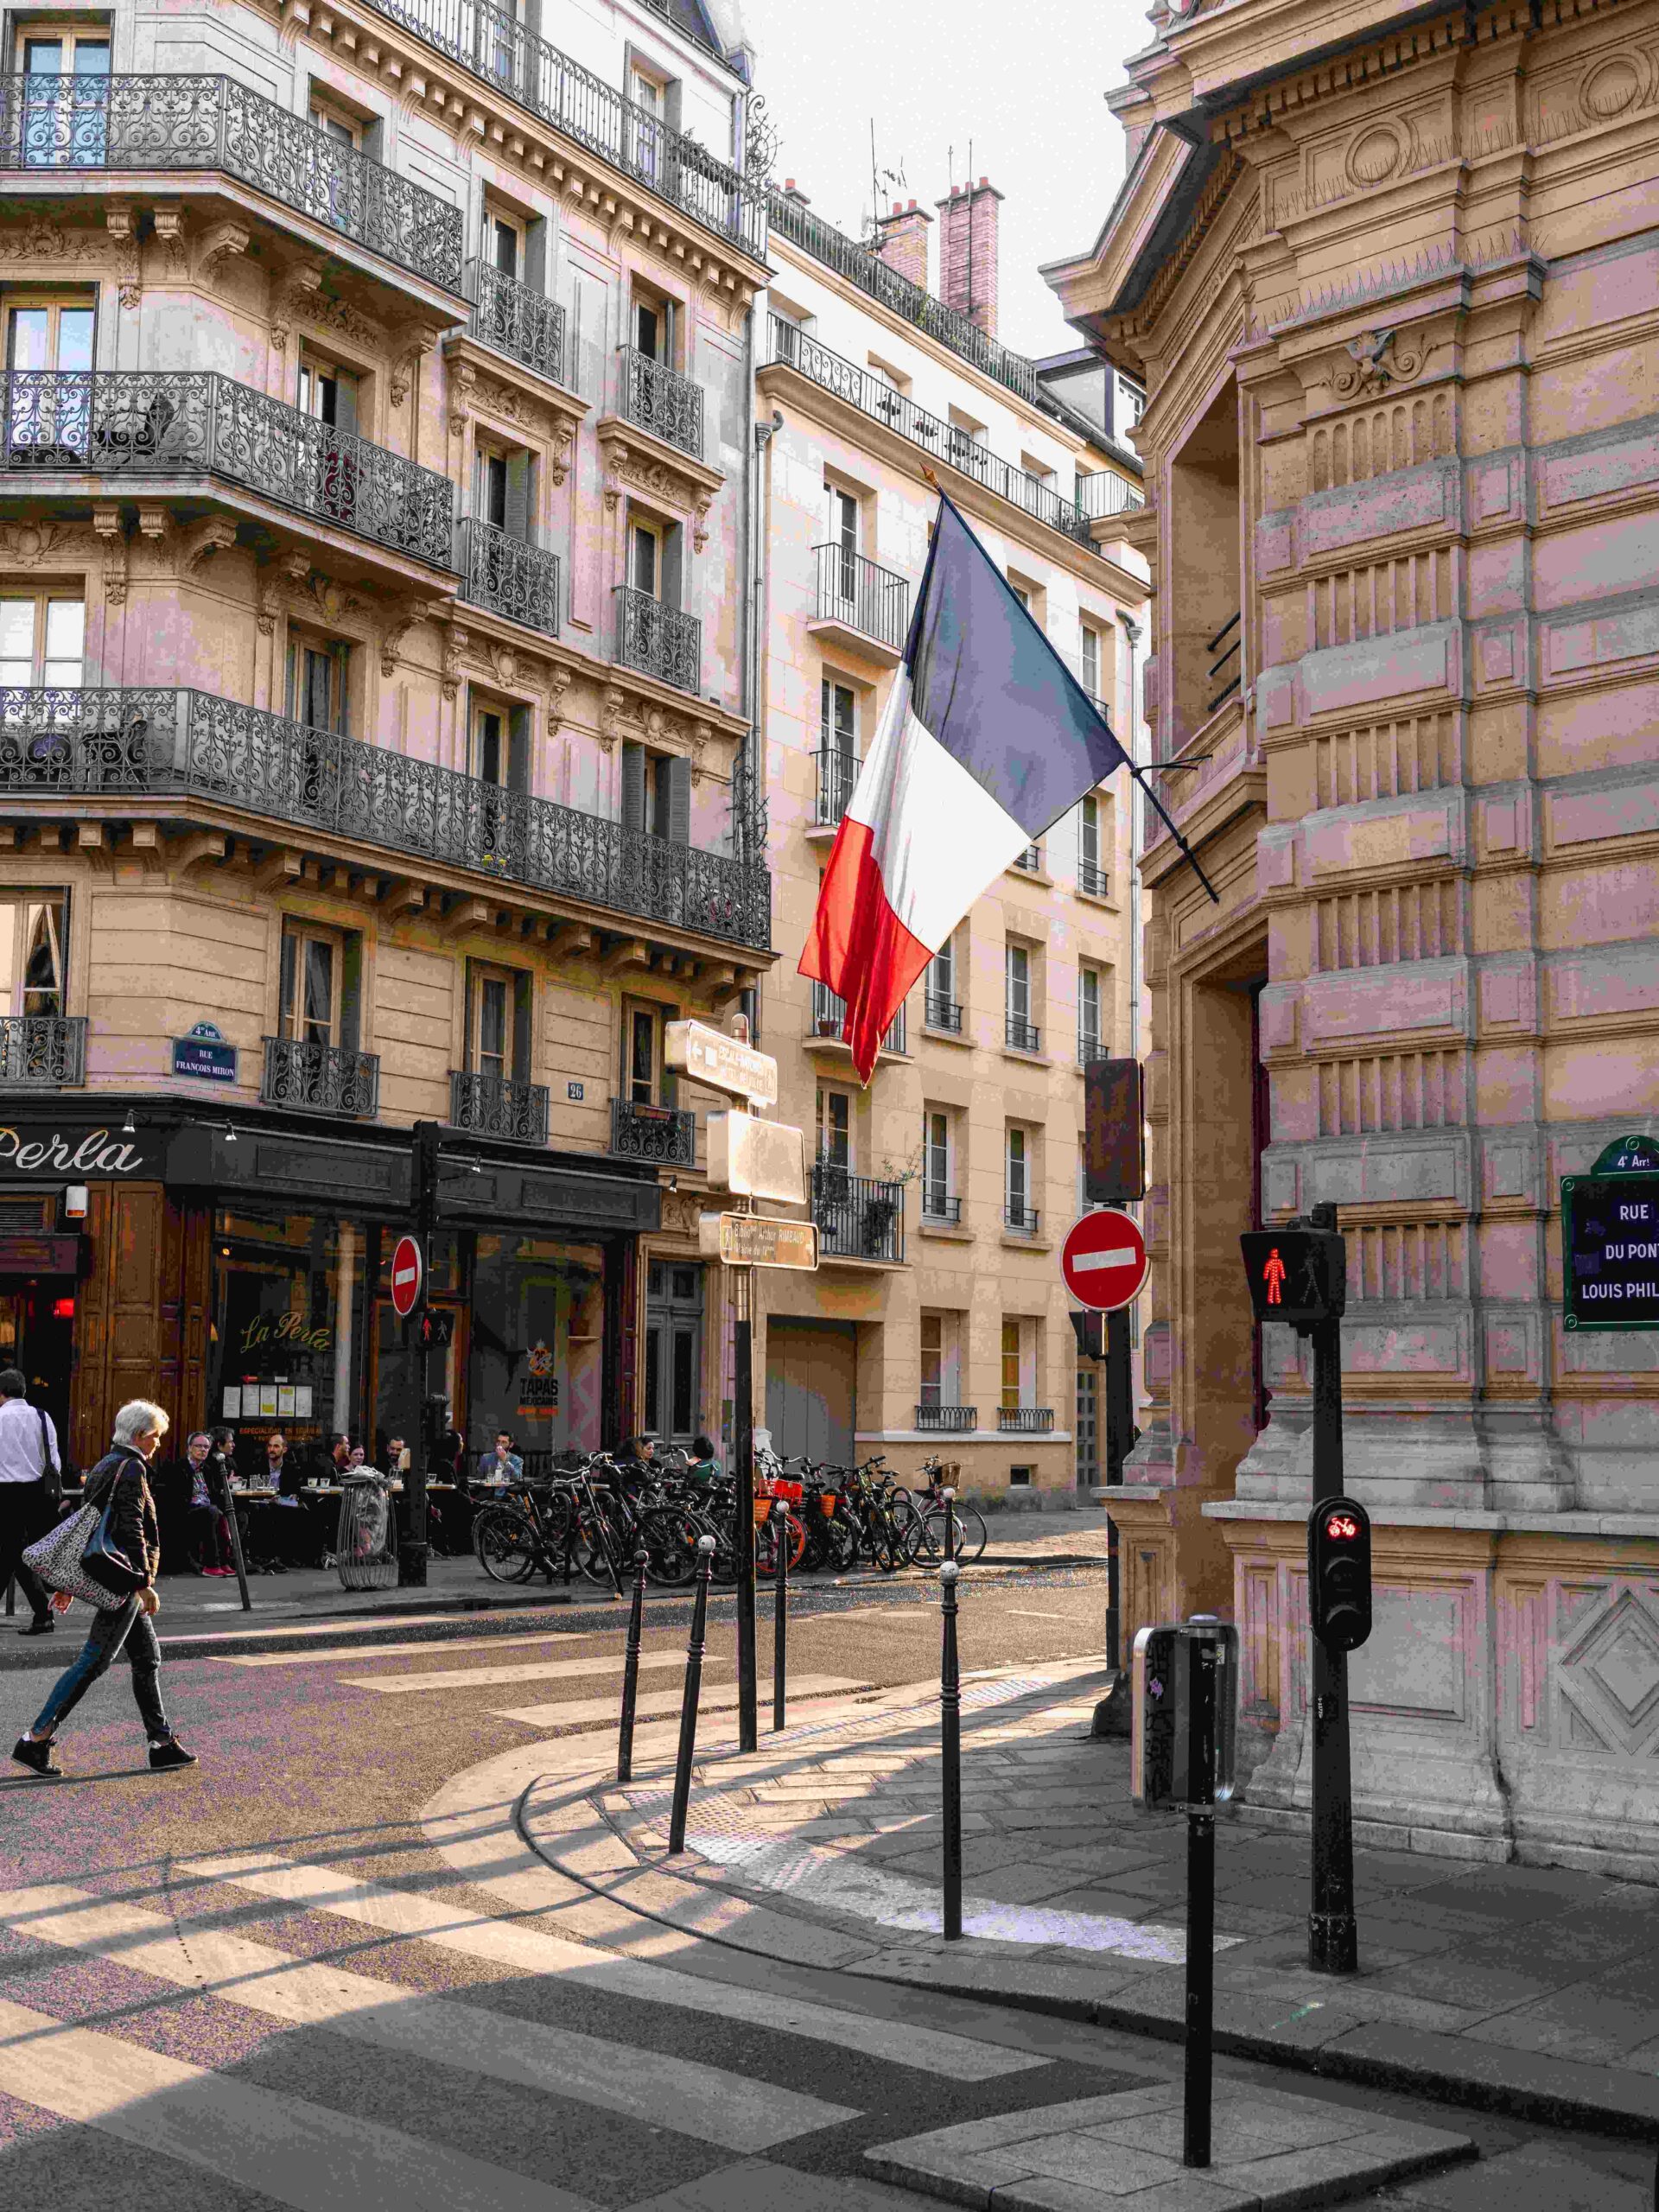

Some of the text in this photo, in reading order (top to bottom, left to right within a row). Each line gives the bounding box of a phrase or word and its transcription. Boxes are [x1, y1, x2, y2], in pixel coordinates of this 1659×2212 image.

[199, 1049, 213, 1059] RUE
[212, 1065, 234, 1077] MIRON
[570, 1084, 582, 1098] 26
[1620, 1204, 1649, 1220] RUE
[758, 1226, 776, 1241] Arthur
[779, 1229, 804, 1244] RIMBAUD
[753, 1246, 760, 1255] du
[1605, 1244, 1624, 1260] DU
[1582, 1283, 1623, 1299] LOUIS
[240, 1312, 330, 1353] La Perla
[520, 1377, 558, 1395] TAPAS
